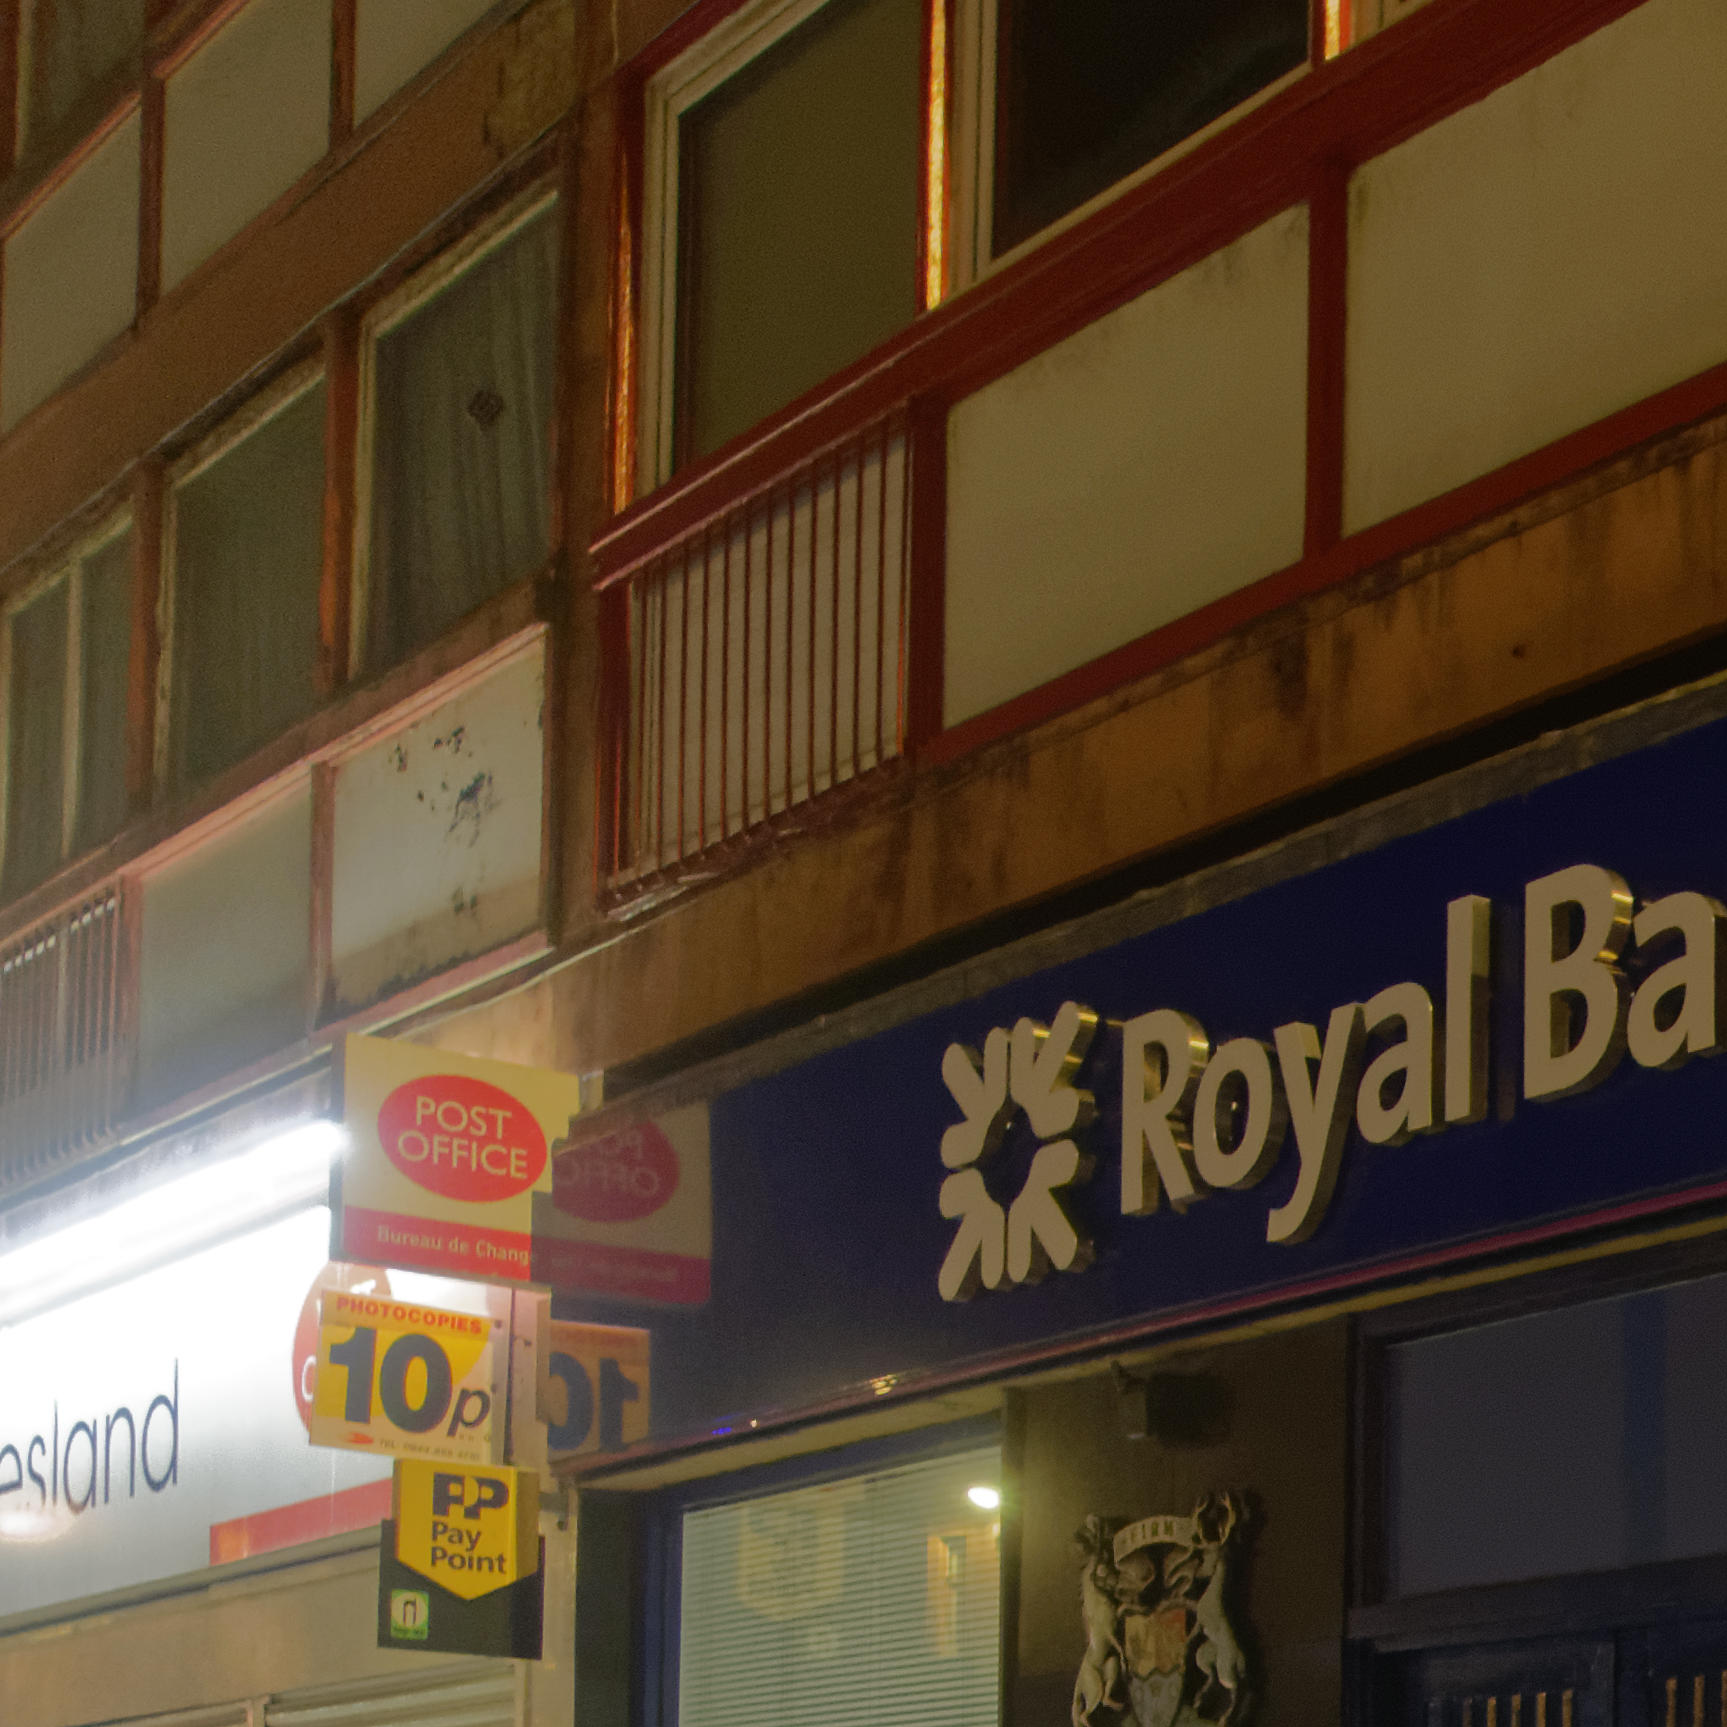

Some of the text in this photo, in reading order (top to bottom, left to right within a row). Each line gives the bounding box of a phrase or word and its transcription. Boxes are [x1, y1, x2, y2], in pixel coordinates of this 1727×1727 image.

[1120, 893, 1492, 1244] Royal
[415, 1095, 513, 1140] POST
[397, 1130, 529, 1180] OFFICE
[377, 1225, 530, 1267] Bureau de Chang
[335, 1294, 483, 1336] PHOTOCOPIES
[328, 1326, 492, 1439] 10p
[431, 1520, 482, 1552] Pay
[430, 1546, 508, 1575] Point
